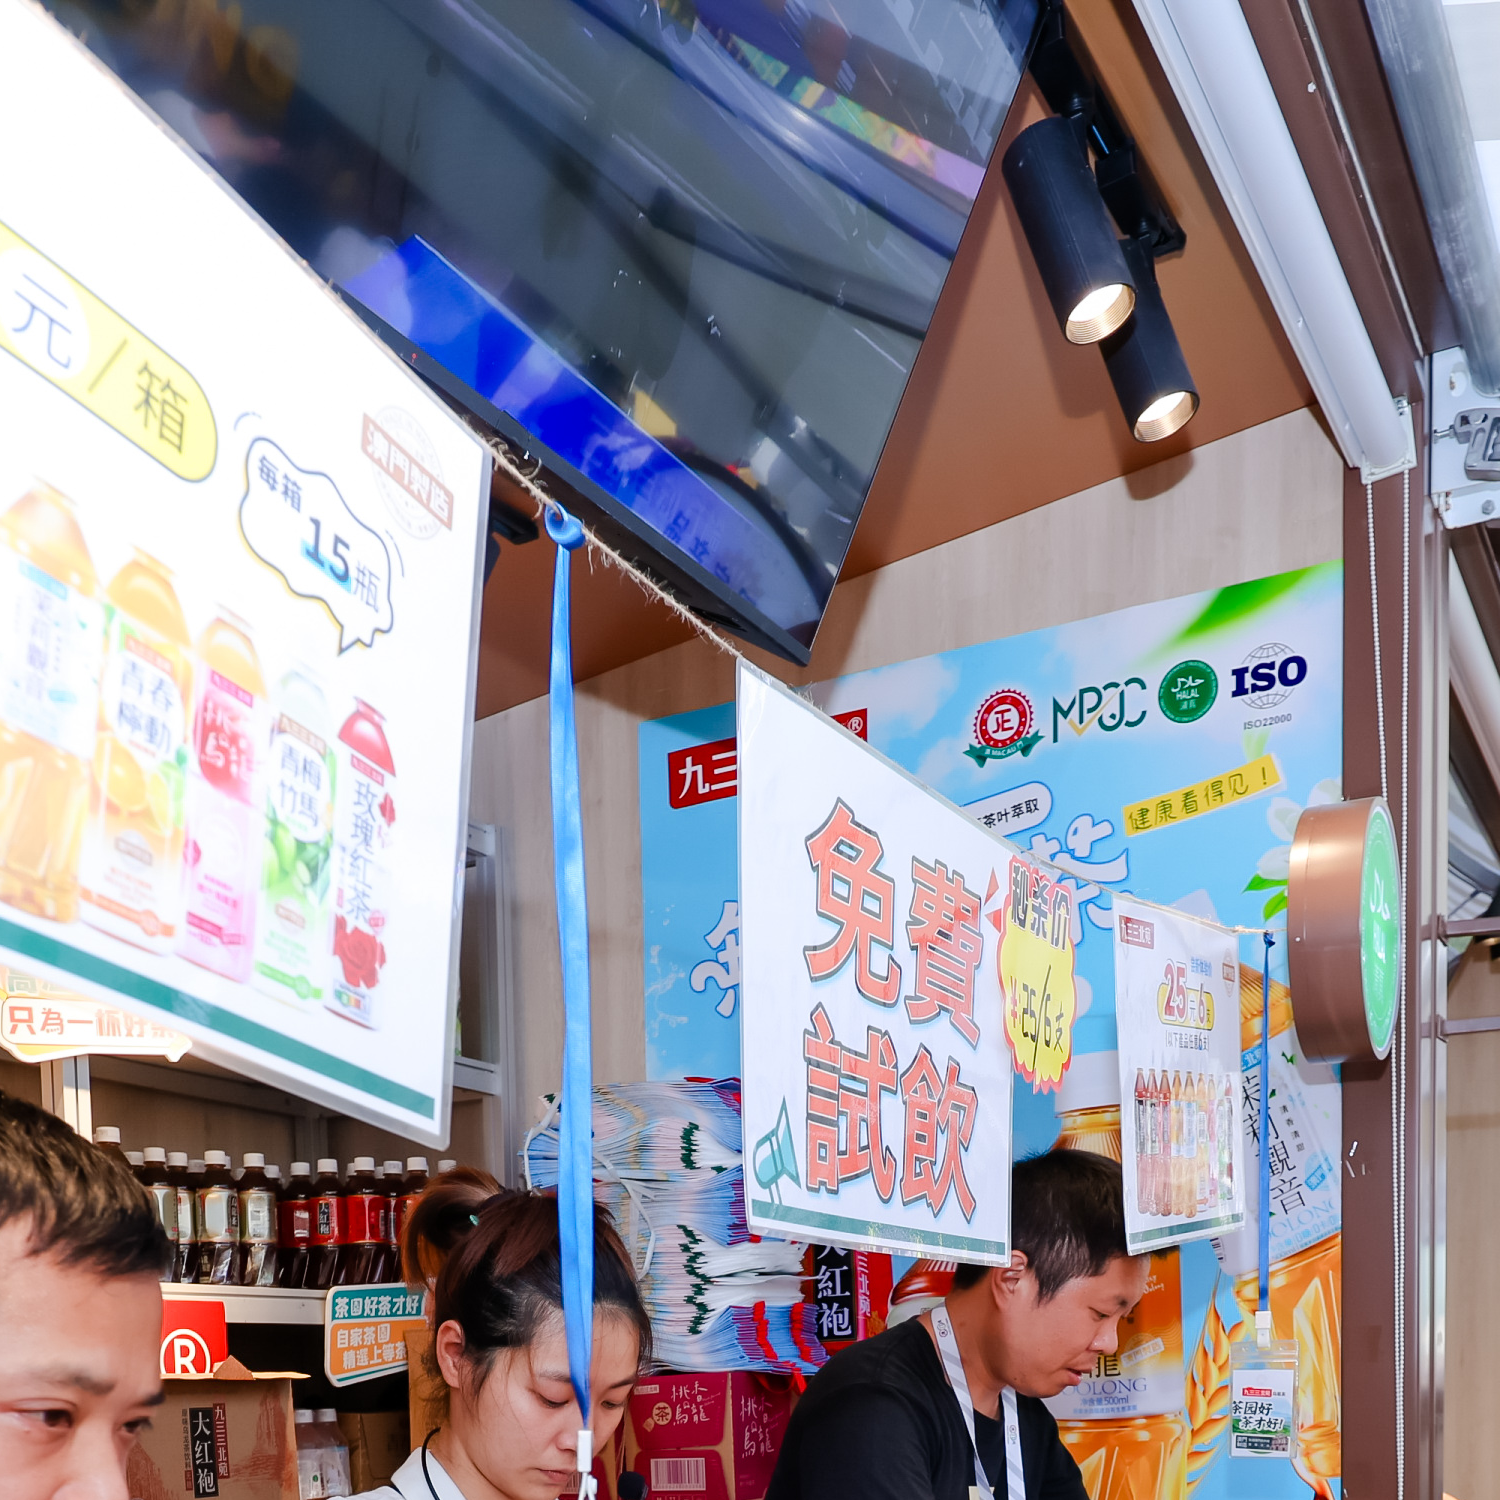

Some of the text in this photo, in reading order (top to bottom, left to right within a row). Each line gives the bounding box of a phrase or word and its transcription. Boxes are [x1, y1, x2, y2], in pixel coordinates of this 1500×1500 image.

[1232, 655, 1308, 699] ISO
[1176, 688, 1200, 700] HALAL
[1243, 713, 1292, 731] ISO22000
[978, 797, 1040, 829] 茶叶萃取
[1011, 862, 1071, 951] 秒杀价
[803, 797, 984, 1049] 免費
[802, 1003, 980, 1224] 試飲
[334, 1293, 420, 1318] 茶園好茶才好
[336, 1323, 391, 1349] 自家茶園
[655, 1405, 670, 1423] 茶
[1232, 1400, 1273, 1416] 茶园好
[192, 1411, 216, 1494] 大红袍
[214, 1405, 230, 1477] 九三三北苑
